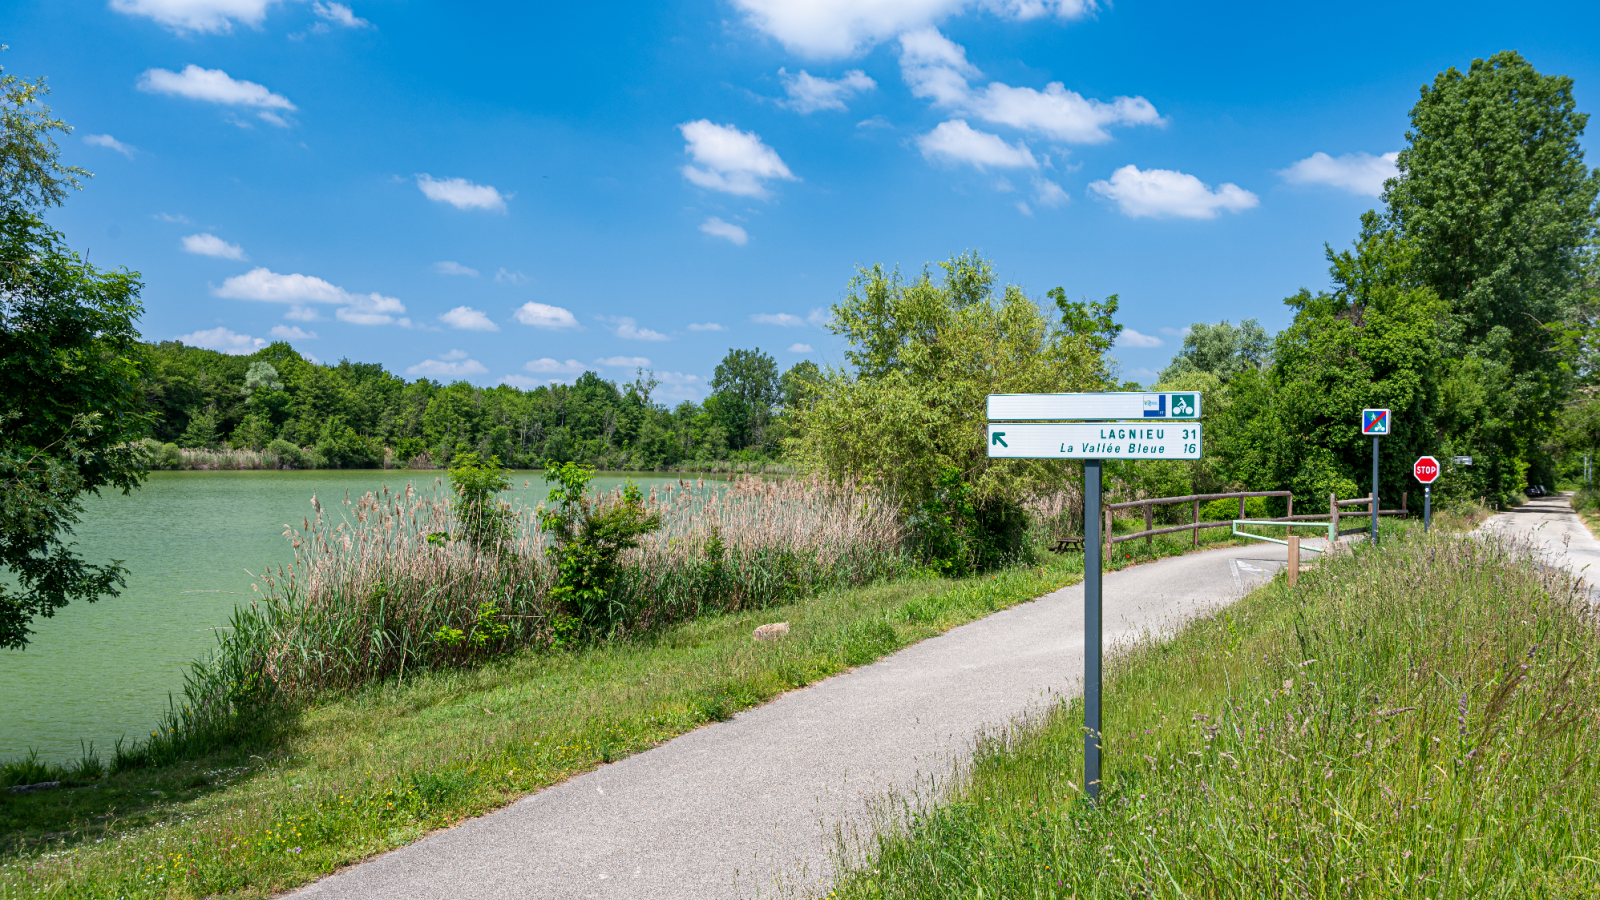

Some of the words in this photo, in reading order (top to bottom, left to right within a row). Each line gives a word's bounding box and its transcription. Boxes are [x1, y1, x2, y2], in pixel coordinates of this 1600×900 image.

[1100, 429, 1164, 440] LAGNIEU
[1182, 429, 1196, 440] 31
[1060, 443, 1074, 453] La
[1082, 443, 1121, 453] Vallée
[1128, 443, 1165, 454] Bleue
[1184, 443, 1197, 454] 16
[1416, 466, 1436, 474] STOP
